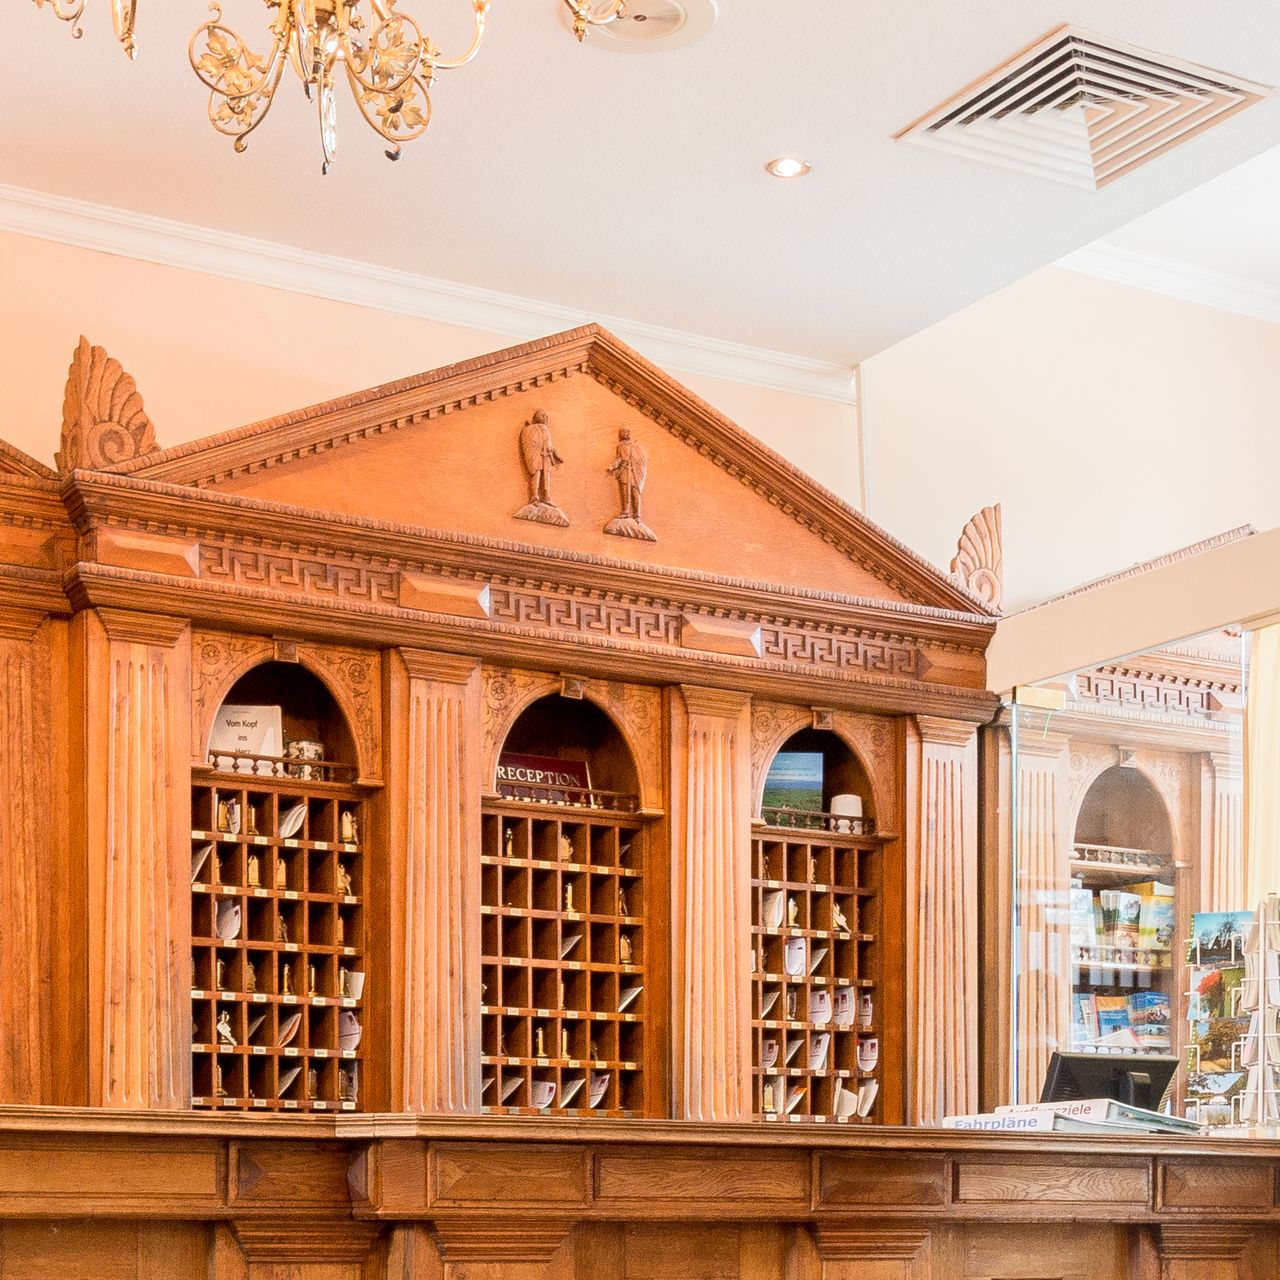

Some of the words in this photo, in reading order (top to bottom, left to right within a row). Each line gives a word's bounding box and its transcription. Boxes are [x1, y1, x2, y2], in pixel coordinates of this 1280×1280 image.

[226, 720, 240, 728] Vom
[242, 720, 258, 729] Kopf
[238, 733, 248, 741] ins
[497, 766, 581, 786] RECEPTION
[954, 1116, 1038, 1130] Fahrpläne
